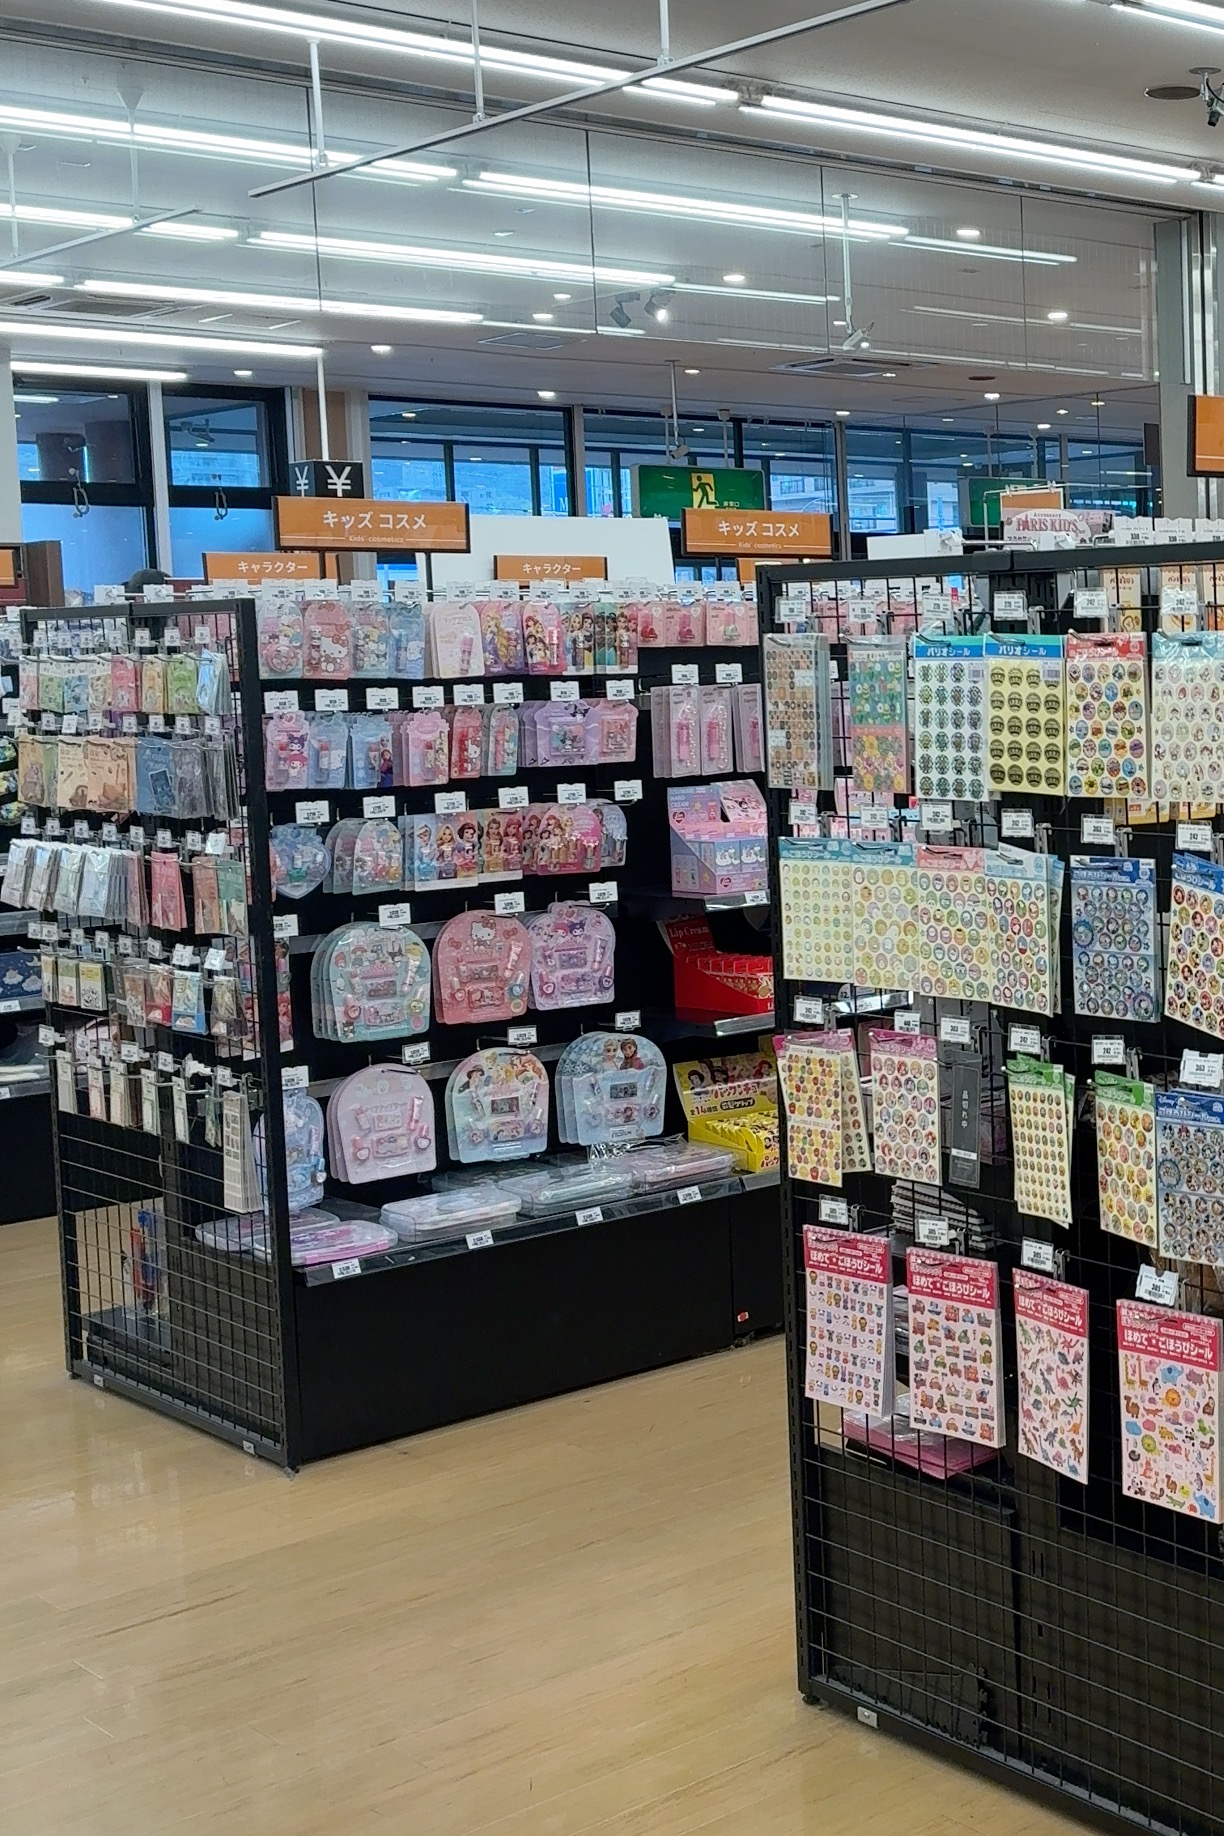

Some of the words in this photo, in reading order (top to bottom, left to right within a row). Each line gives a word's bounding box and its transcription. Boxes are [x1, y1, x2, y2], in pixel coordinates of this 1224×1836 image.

[325, 465, 352, 497] ¥
[322, 511, 373, 529] キッズ
[379, 513, 427, 530] コスメ
[718, 521, 757, 537] キッズ
[762, 522, 799, 537] コスメ
[1016, 513, 1048, 532] PARIS
[237, 561, 308, 573] キャラクター
[522, 563, 581, 574] キャラクター
[927, 647, 971, 656] パリオシール
[999, 645, 1047, 656] パリオシール
[669, 928, 683, 938] Lip
[685, 926, 709, 936] Cream
[713, 1083, 758, 1099] パックンチョ
[961, 1090, 969, 1129] 品切れ中
[809, 1251, 830, 1263] ほめて
[838, 1255, 883, 1275] ごほうびシール
[912, 1275, 933, 1289] ほめて
[942, 1279, 991, 1300] ごほうびシール
[1018, 1295, 1036, 1310] ほめて
[1041, 1303, 1083, 1327] ごほうびシール
[1124, 1329, 1148, 1345] ほめて
[1158, 1336, 1214, 1360] ごほうびシール
